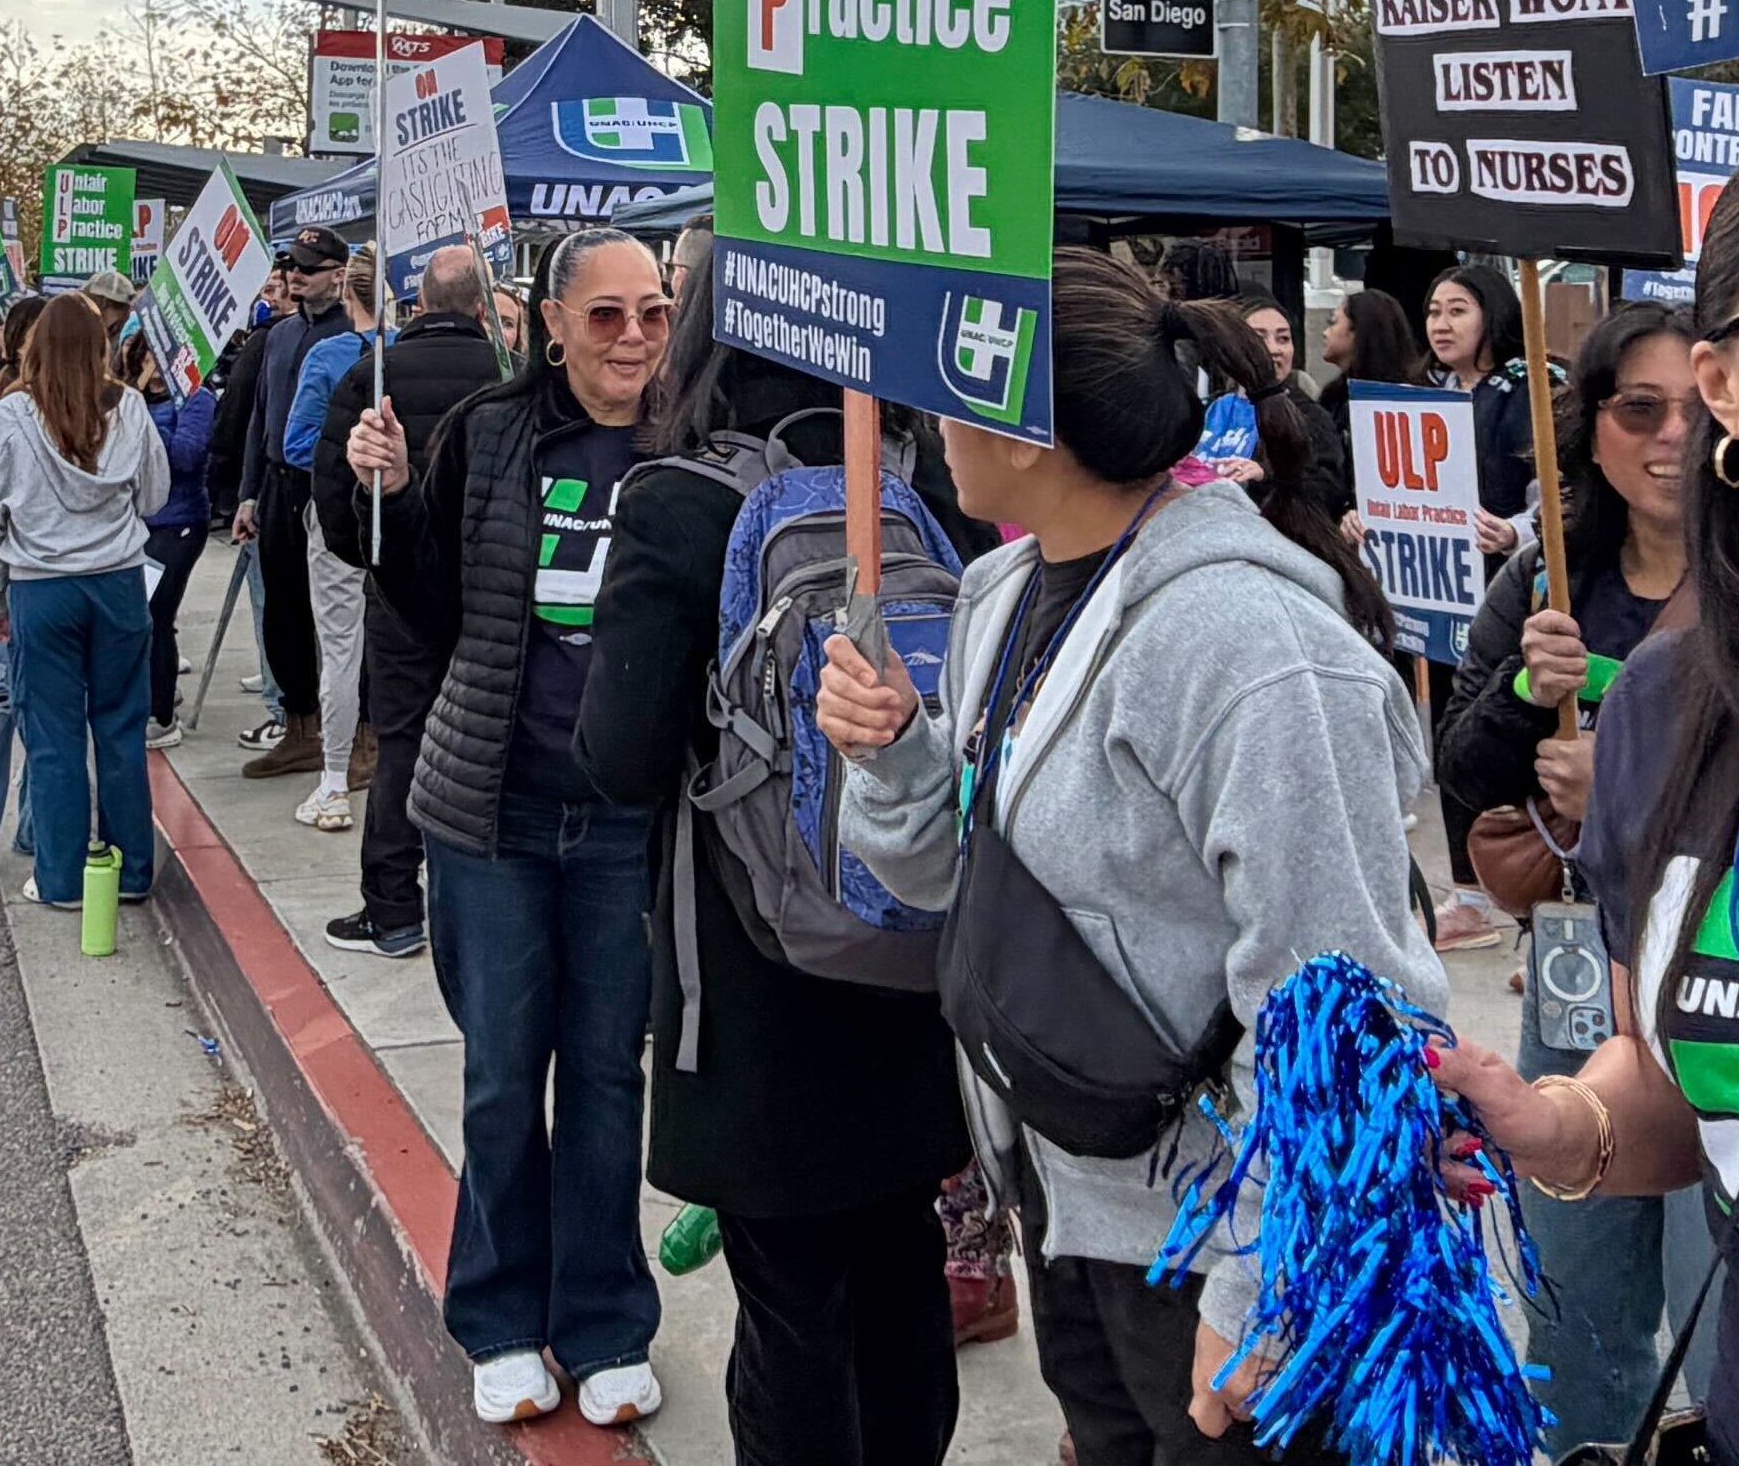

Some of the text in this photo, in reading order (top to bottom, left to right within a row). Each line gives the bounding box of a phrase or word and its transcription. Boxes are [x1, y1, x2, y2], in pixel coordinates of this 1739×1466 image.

[1151, 0, 1206, 29] Diego
[415, 68, 438, 99] ON
[1441, 58, 1568, 102] LISTEN
[396, 88, 467, 146] STRIKE
[754, 101, 992, 258] STRIKE
[1414, 149, 1627, 197] TO NURSES
[54, 247, 117, 274] STRIKE
[214, 204, 250, 273] ON
[178, 226, 238, 341] STRIKE
[725, 251, 886, 338] #UNACUHCPstrong
[725, 298, 872, 383] #TogetherWeWin
[1373, 410, 1449, 491] ULP
[1364, 528, 1475, 606] STRIKE
